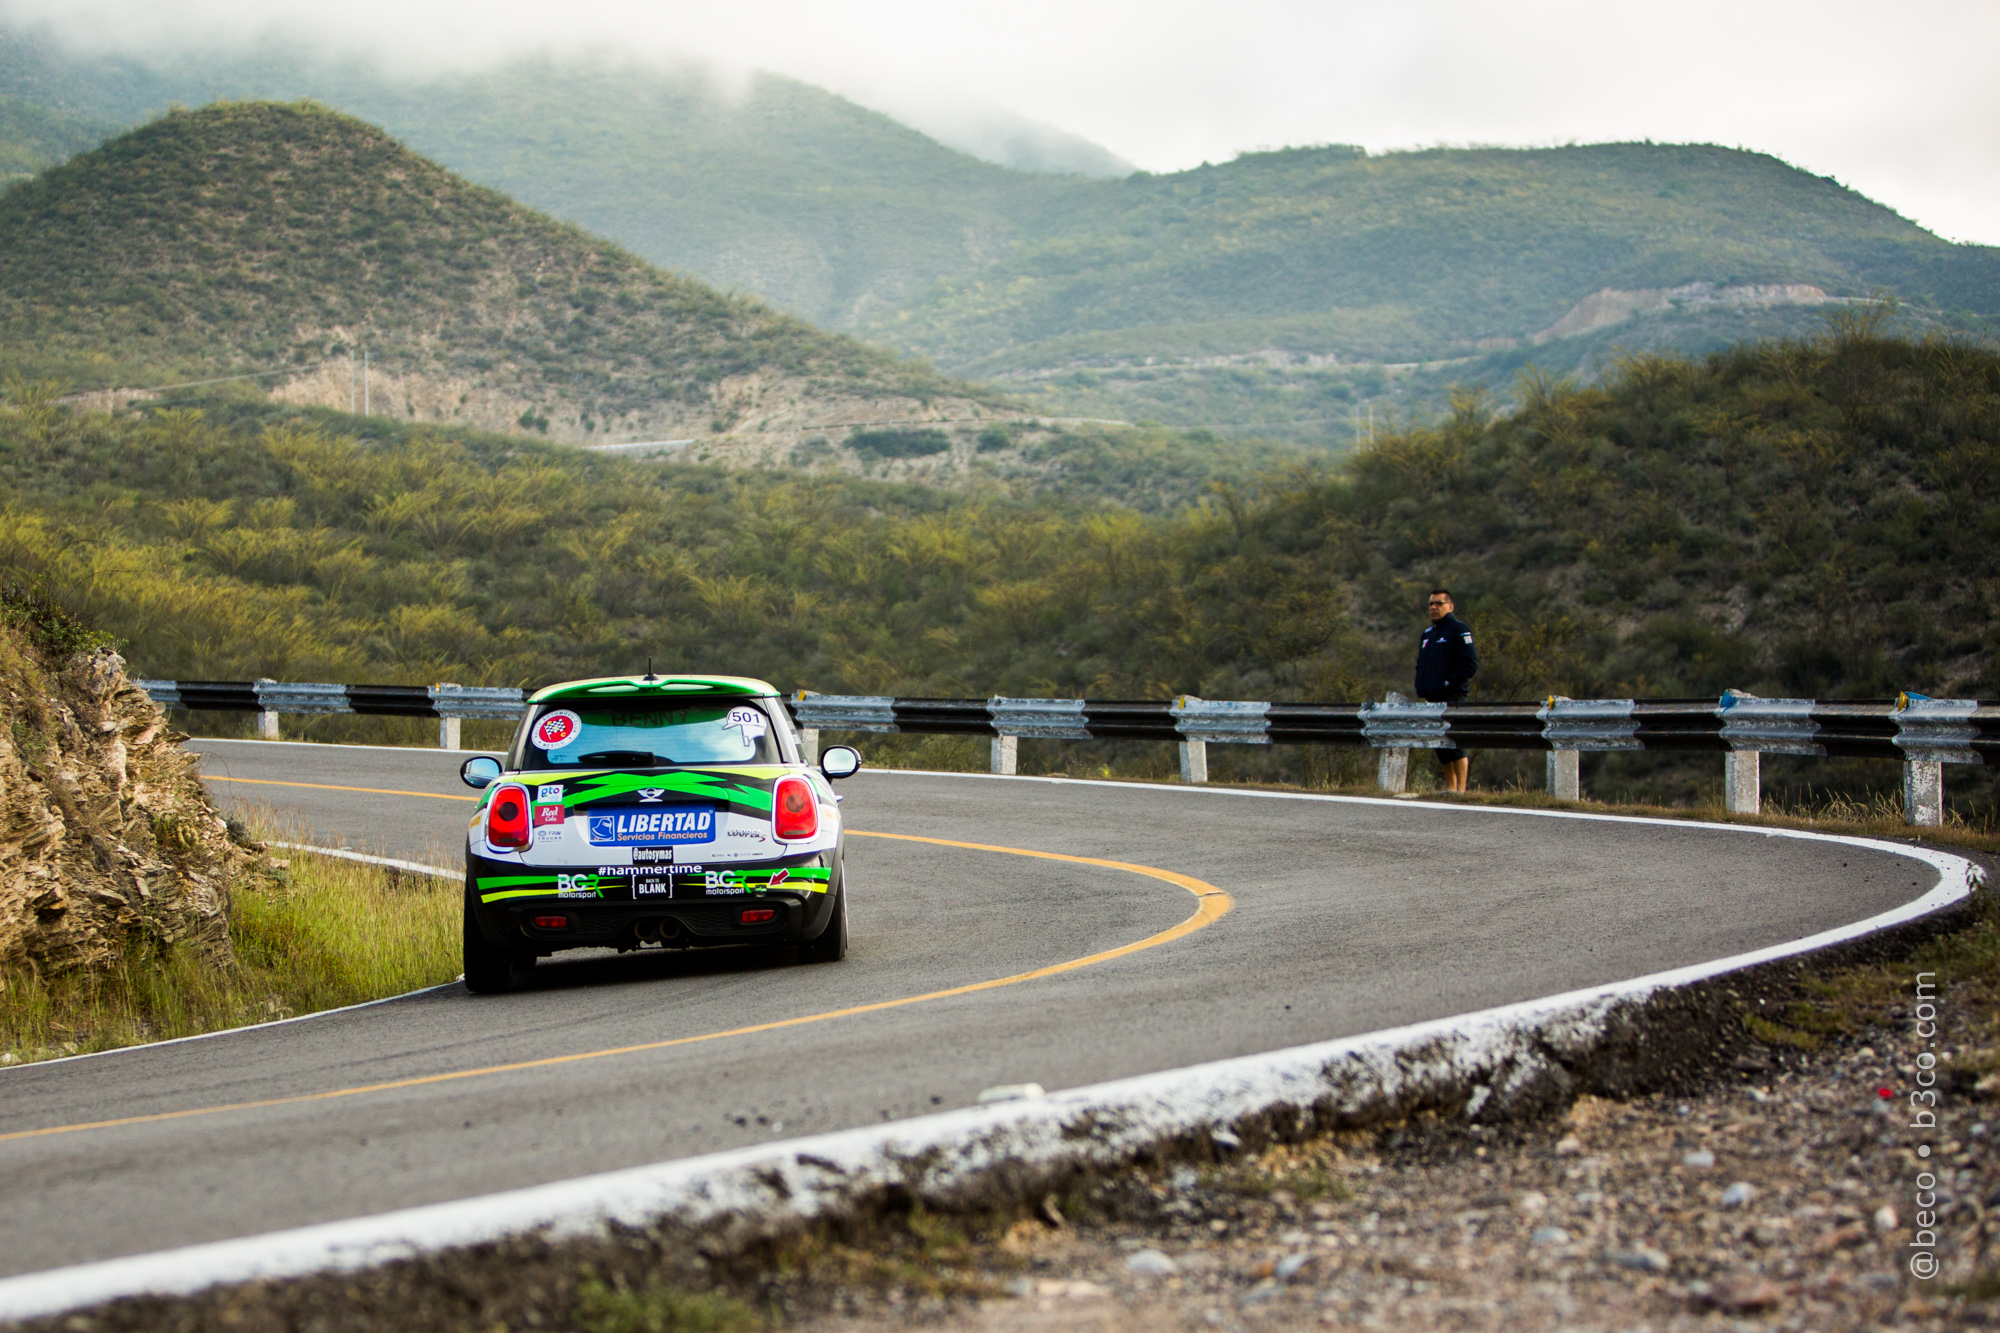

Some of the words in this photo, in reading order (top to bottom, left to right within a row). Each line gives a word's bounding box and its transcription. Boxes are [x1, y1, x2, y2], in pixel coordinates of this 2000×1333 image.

[612, 710, 688, 726] BENNY
[732, 711, 760, 724] 501
[541, 787, 560, 798] gto
[541, 806, 559, 817] Red
[545, 814, 557, 822] Cola
[617, 812, 711, 833] LIBERTAD
[617, 833, 655, 842] Servicios
[658, 831, 708, 841] Financieros
[728, 828, 761, 839] COOPER
[758, 834, 767, 843] S
[633, 847, 673, 863] @autosymas
[598, 864, 702, 876] #hammertime
[639, 883, 667, 894] BLANK
[705, 886, 745, 895] motorsport
[558, 891, 597, 899] motorsport
